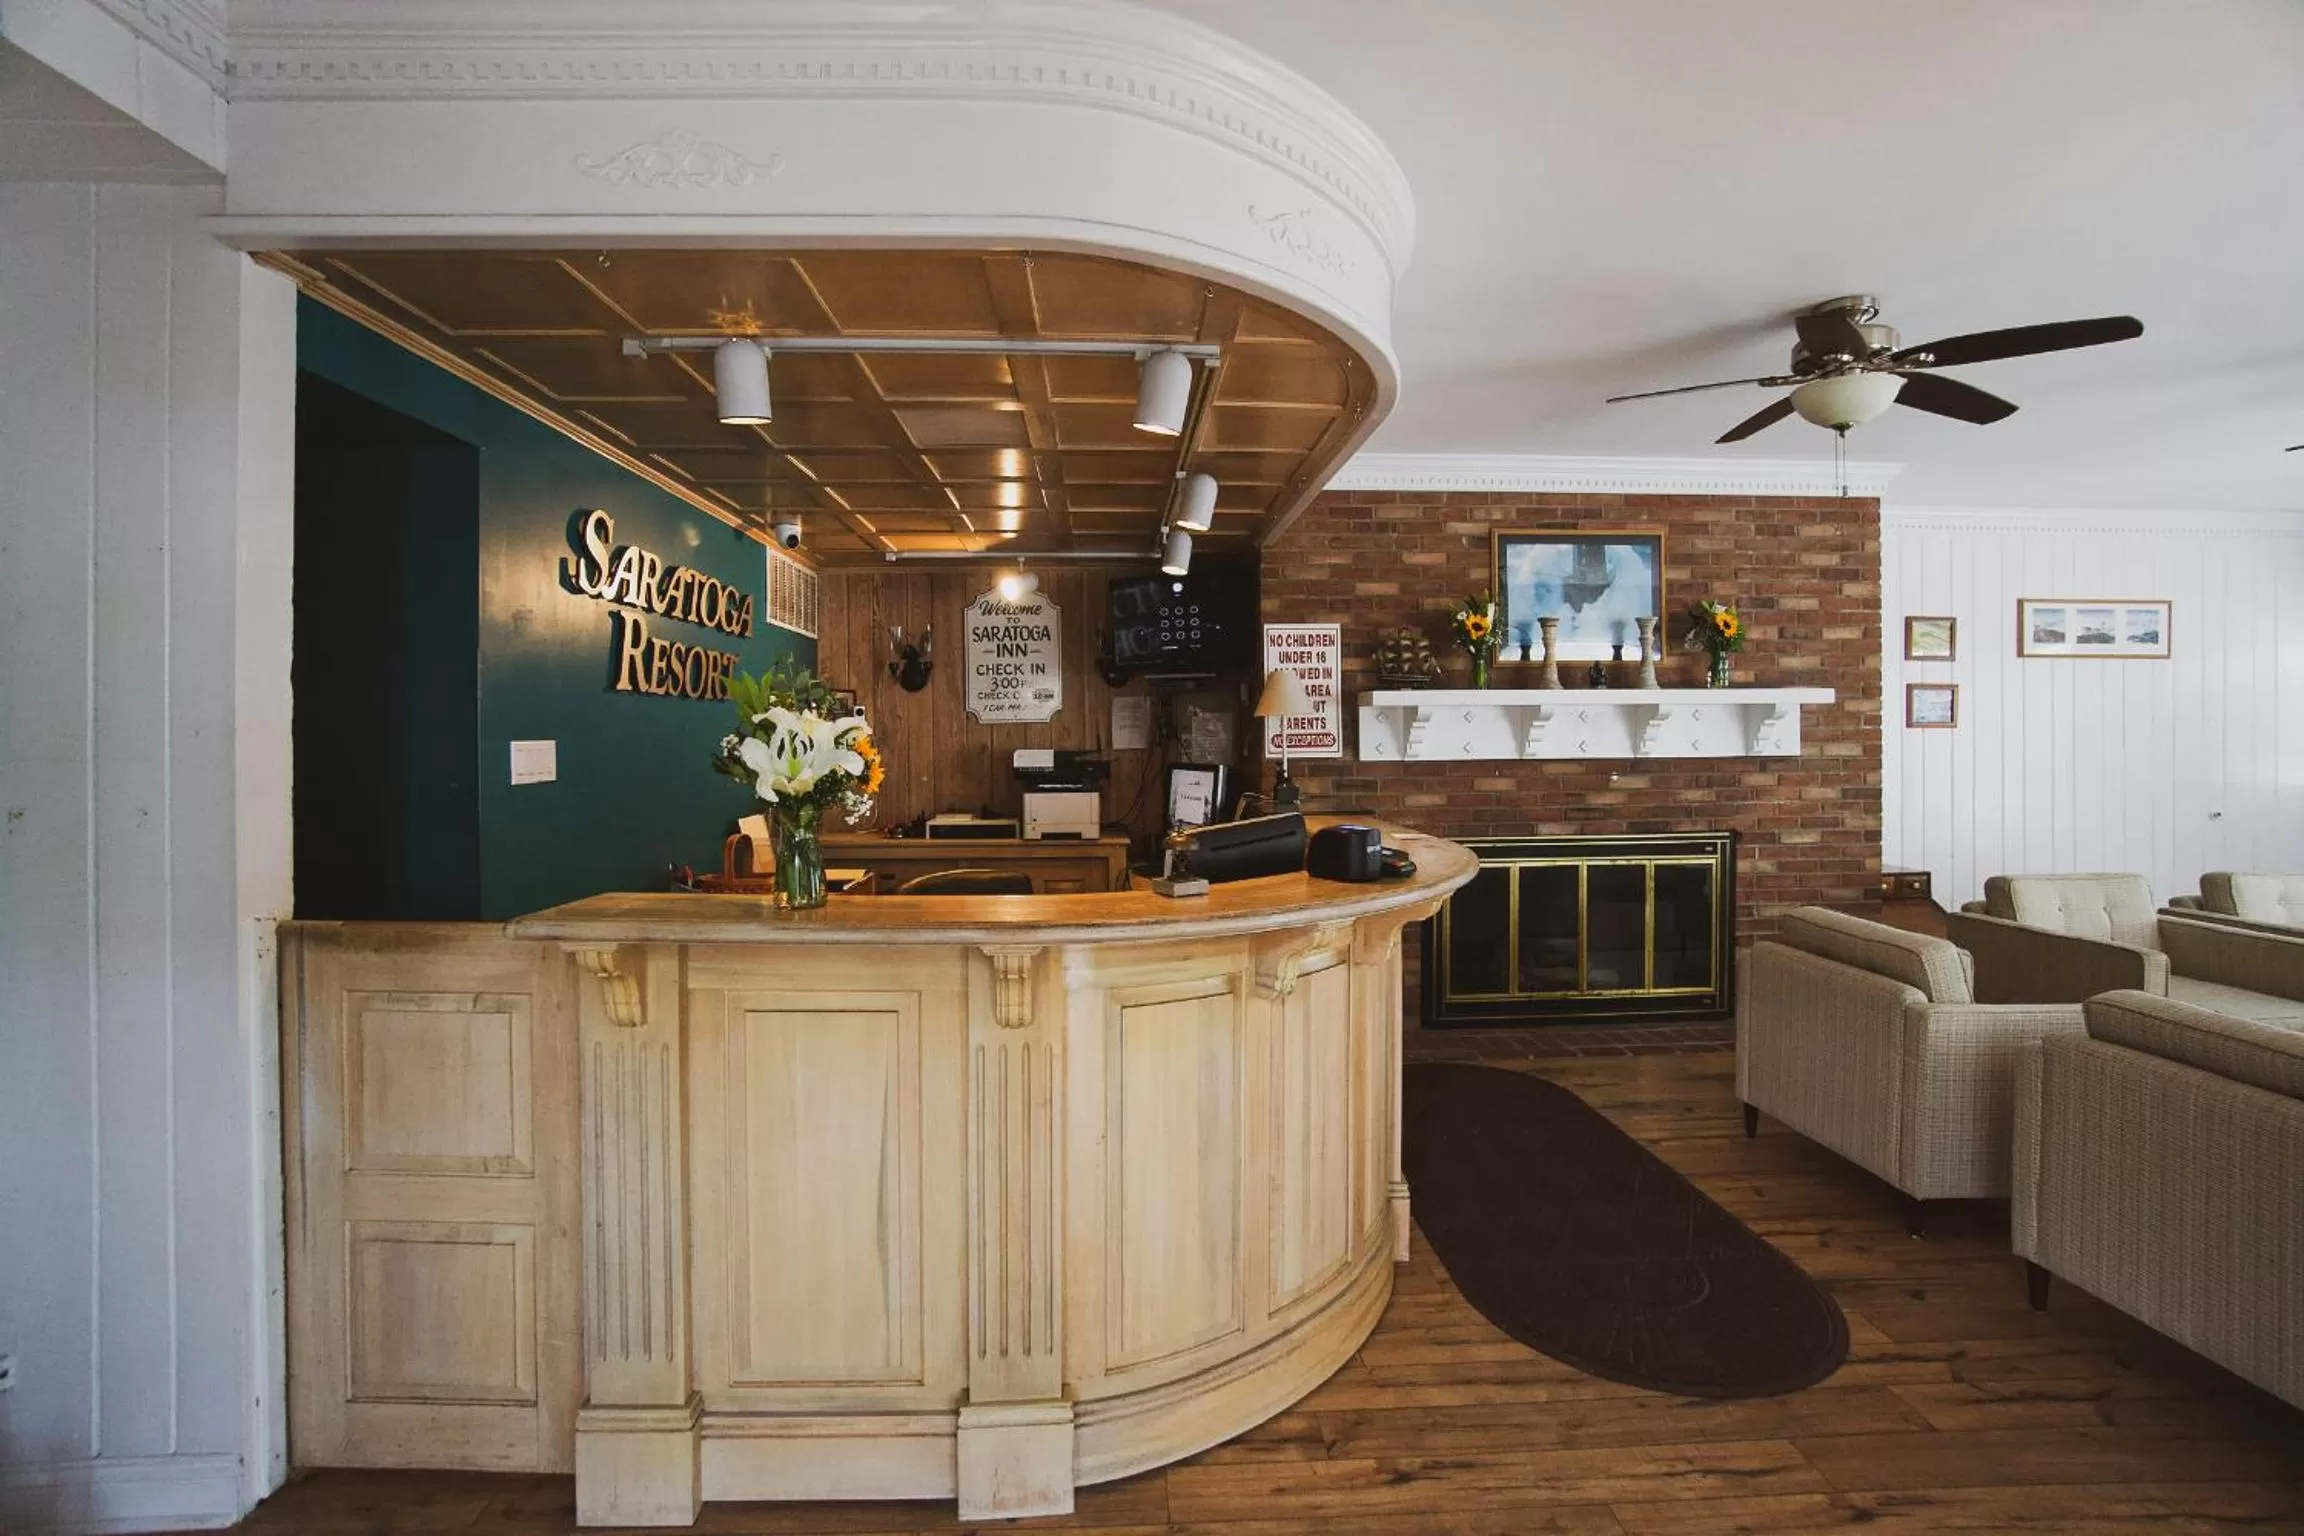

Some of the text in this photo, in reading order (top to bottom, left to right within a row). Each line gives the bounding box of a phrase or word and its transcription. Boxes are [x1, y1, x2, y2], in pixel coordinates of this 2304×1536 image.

[576, 509, 753, 637] SARATOGA
[979, 600, 1042, 616] Welcome
[972, 627, 1051, 642] SARATOGA
[1270, 634, 1335, 647] NO CHILDREN
[616, 610, 740, 699] RESORT
[996, 644, 1028, 657] INN
[1279, 651, 1326, 663] UNDER 16
[976, 664, 1045, 676] CHECK IN
[977, 691, 1011, 701] CHECK
[1288, 735, 1334, 745] EXCEPTIONS
